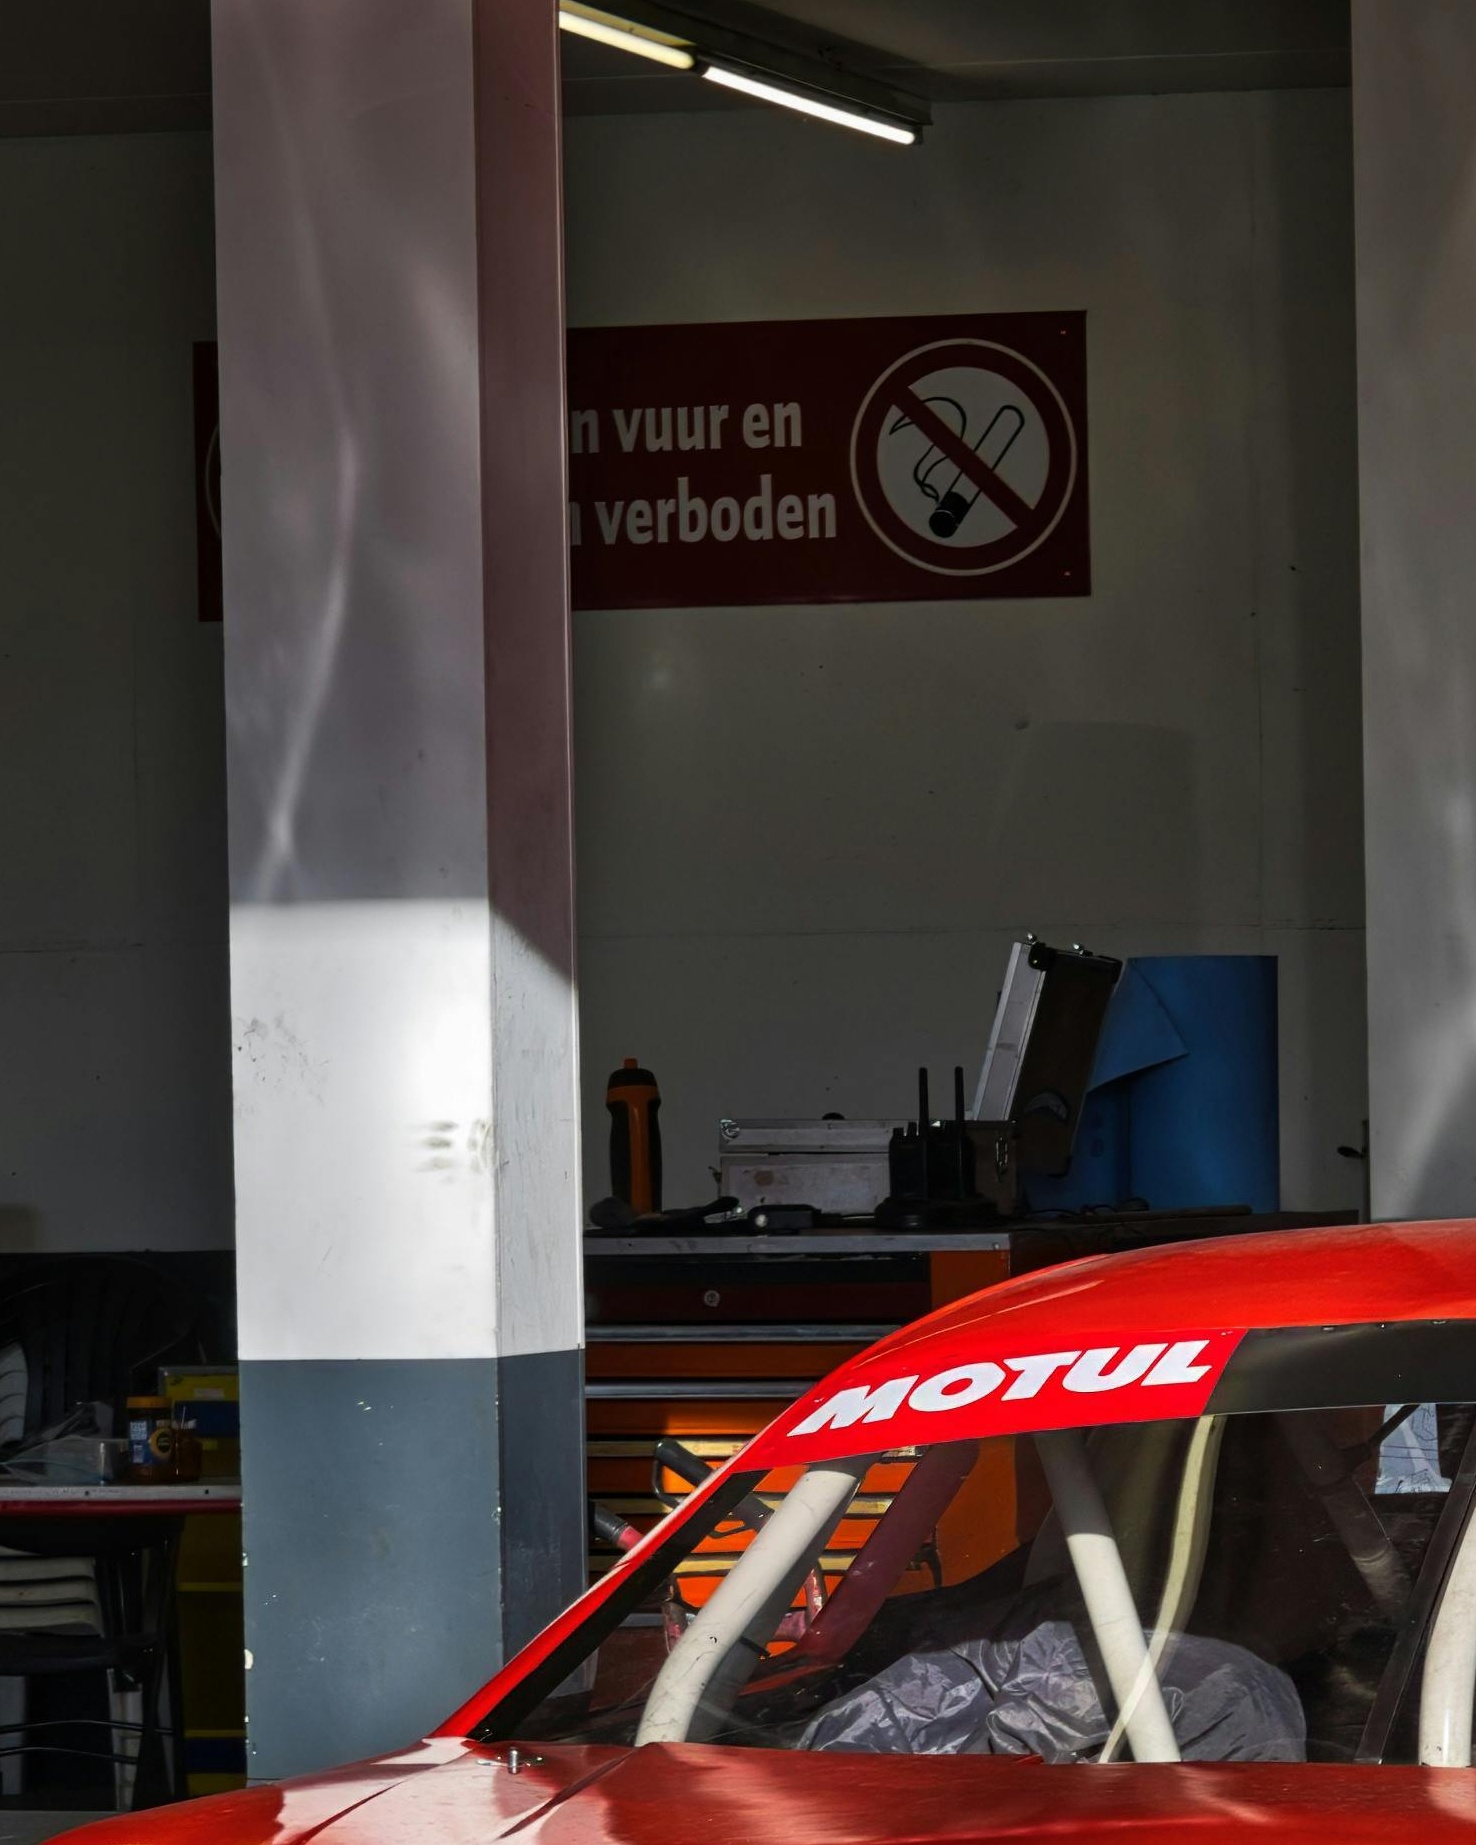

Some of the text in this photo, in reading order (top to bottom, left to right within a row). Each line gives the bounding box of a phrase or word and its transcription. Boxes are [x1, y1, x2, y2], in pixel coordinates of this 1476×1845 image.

[612, 404, 730, 453] vuur
[742, 401, 803, 448] en
[594, 473, 838, 546] verboden
[787, 1341, 1212, 1437] MOTUL
